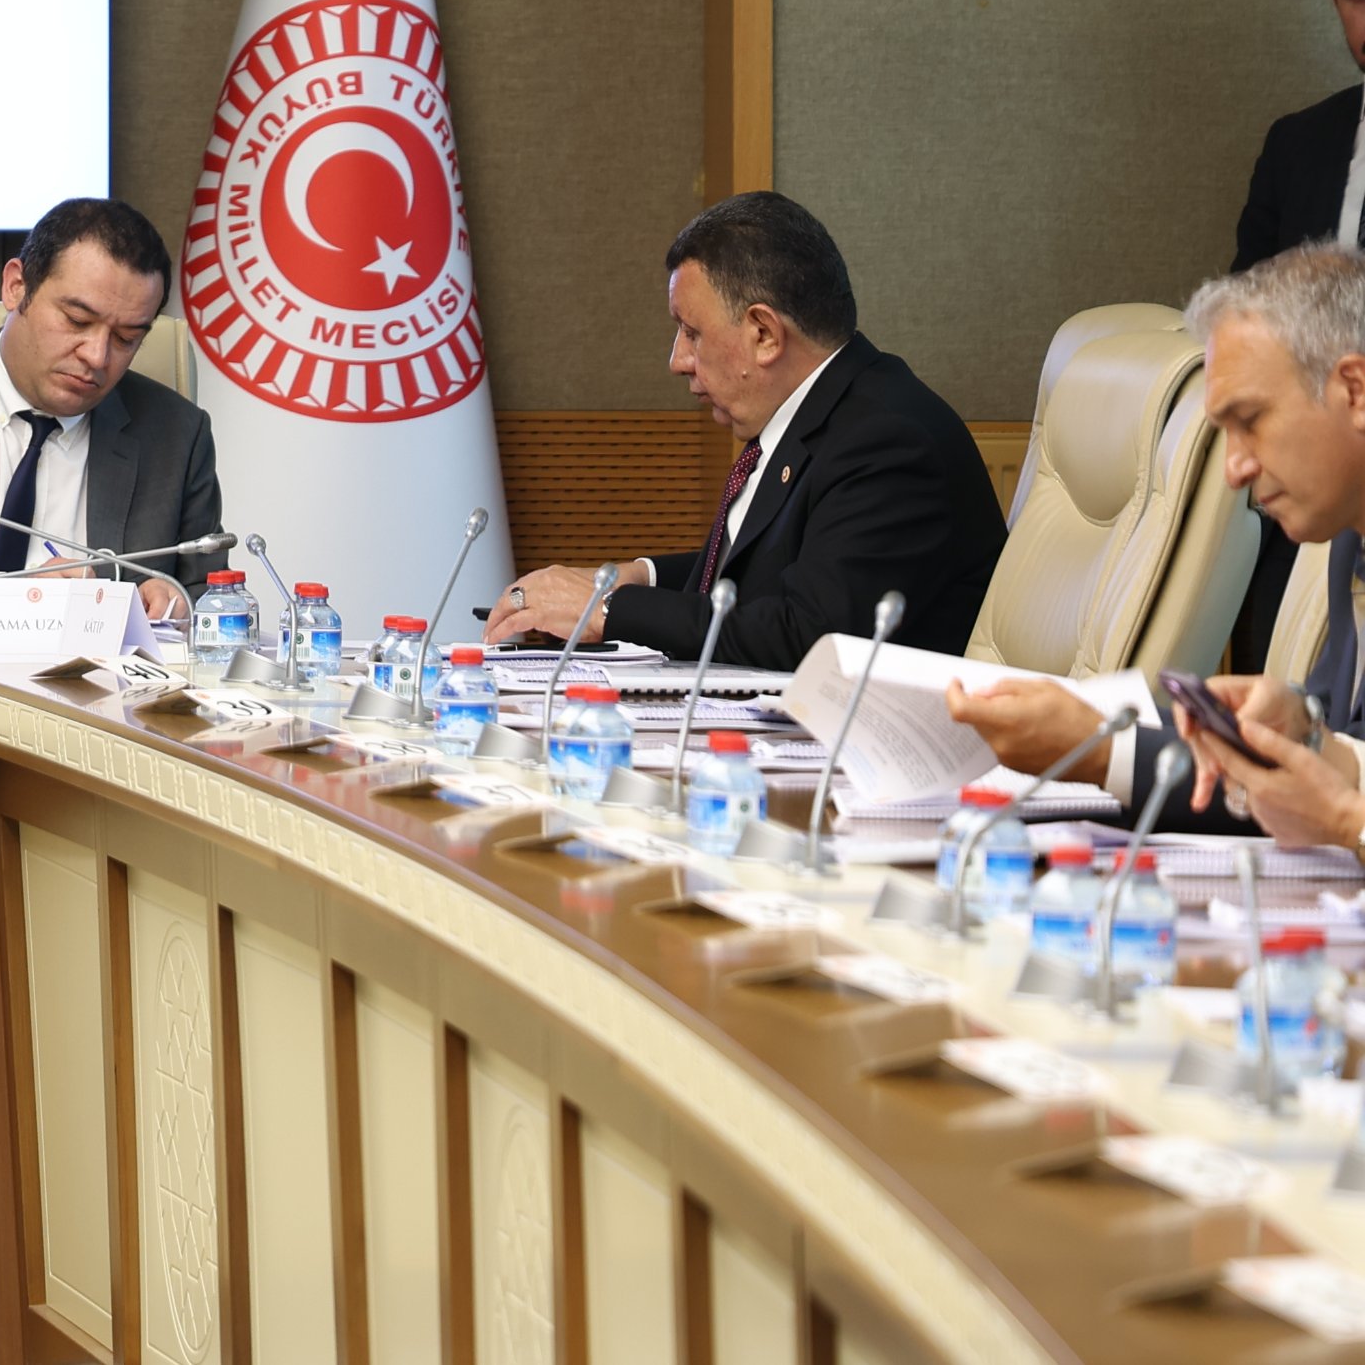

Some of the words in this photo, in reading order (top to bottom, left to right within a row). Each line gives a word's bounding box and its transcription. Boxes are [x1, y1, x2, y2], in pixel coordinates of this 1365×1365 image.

[238, 70, 364, 168] BÜYÜK
[227, 183, 302, 323] MİLLET
[309, 272, 465, 349] MECLİSİ
[121, 664, 170, 680] 40
[216, 699, 272, 717] 39
